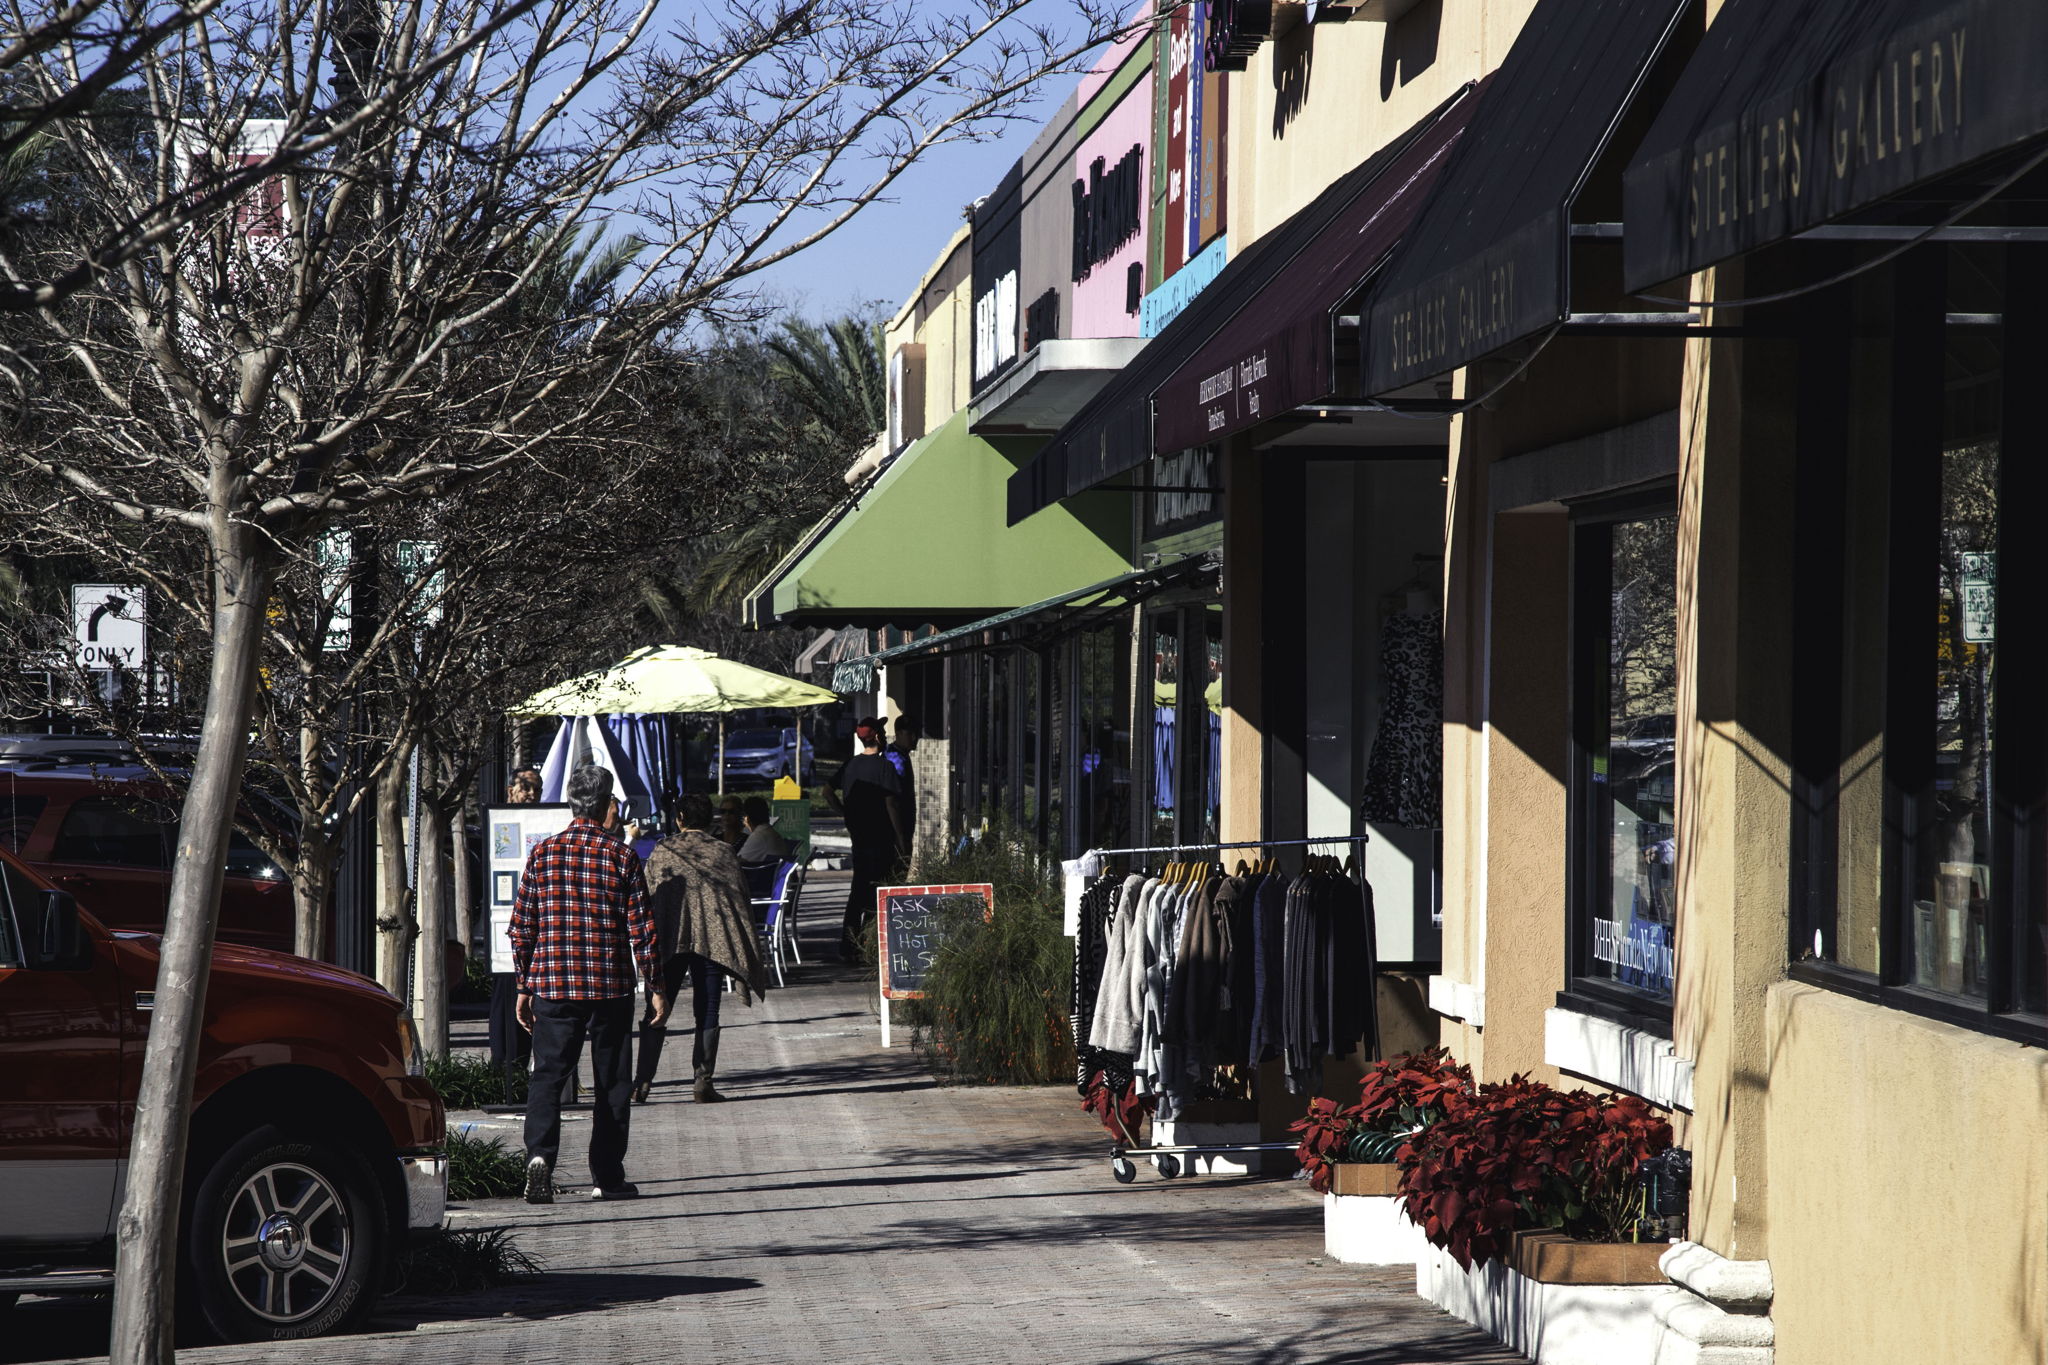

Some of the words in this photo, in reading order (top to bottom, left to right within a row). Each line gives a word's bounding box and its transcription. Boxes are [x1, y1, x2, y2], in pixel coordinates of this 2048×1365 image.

[1170, 24, 1187, 80] Books
[1691, 107, 1802, 239] STELLERS
[1833, 28, 1966, 180] GALLERY
[83, 646, 135, 663] ONLY
[891, 898, 931, 914] ASK
[273, 1279, 361, 1339] MICHELIN
